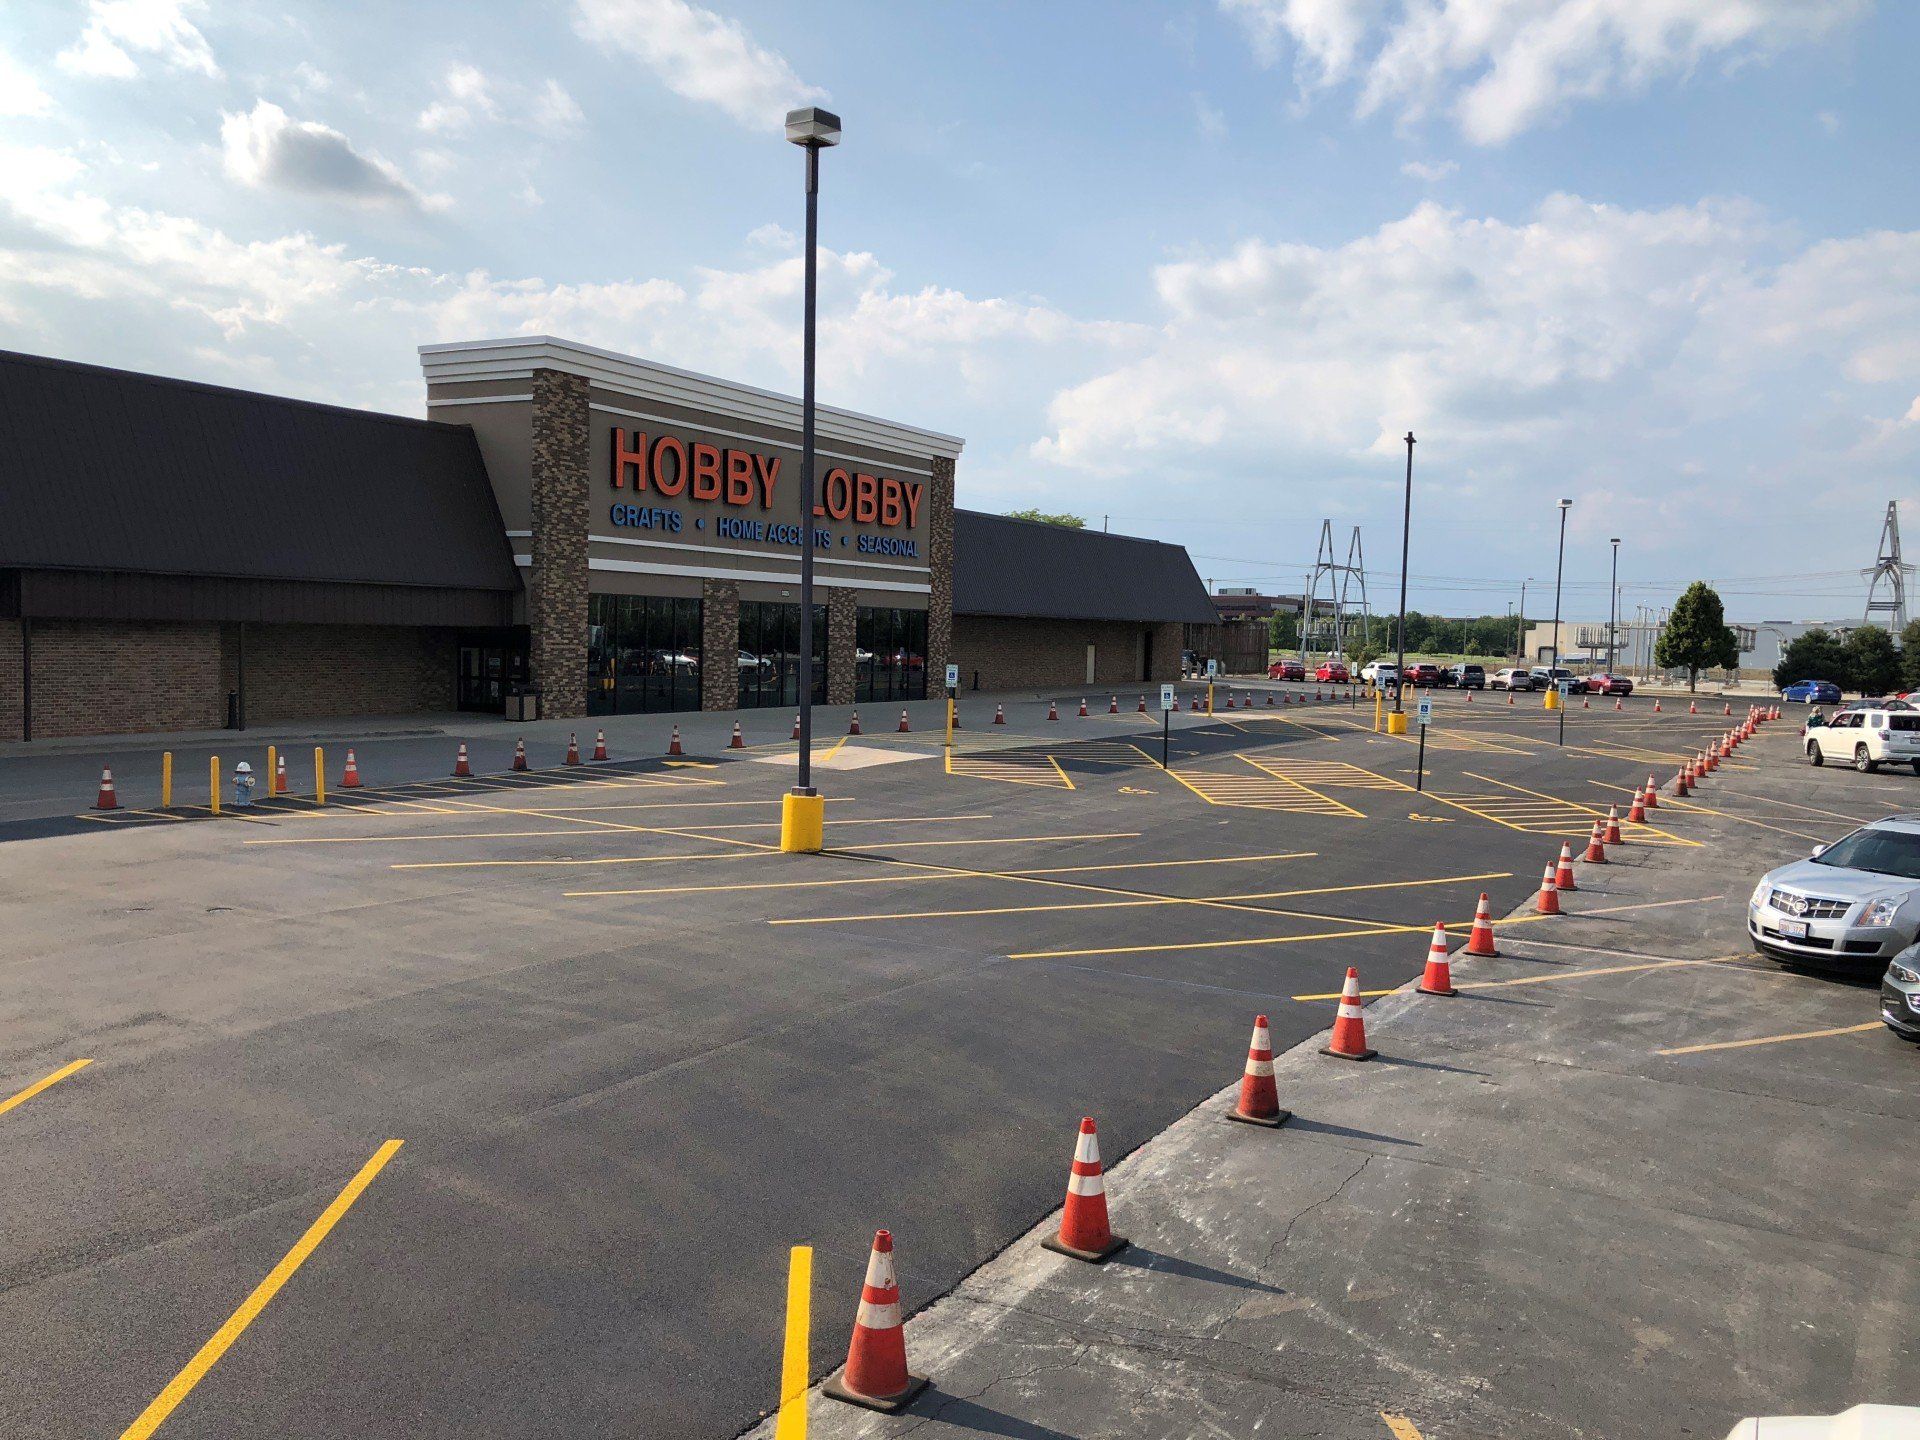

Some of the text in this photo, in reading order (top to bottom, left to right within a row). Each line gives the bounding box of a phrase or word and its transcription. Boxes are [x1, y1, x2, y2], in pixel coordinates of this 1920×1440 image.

[611, 427, 781, 508] HOBBY
[610, 503, 920, 558] CRAFTS HOME ACCETS SEASONAL
